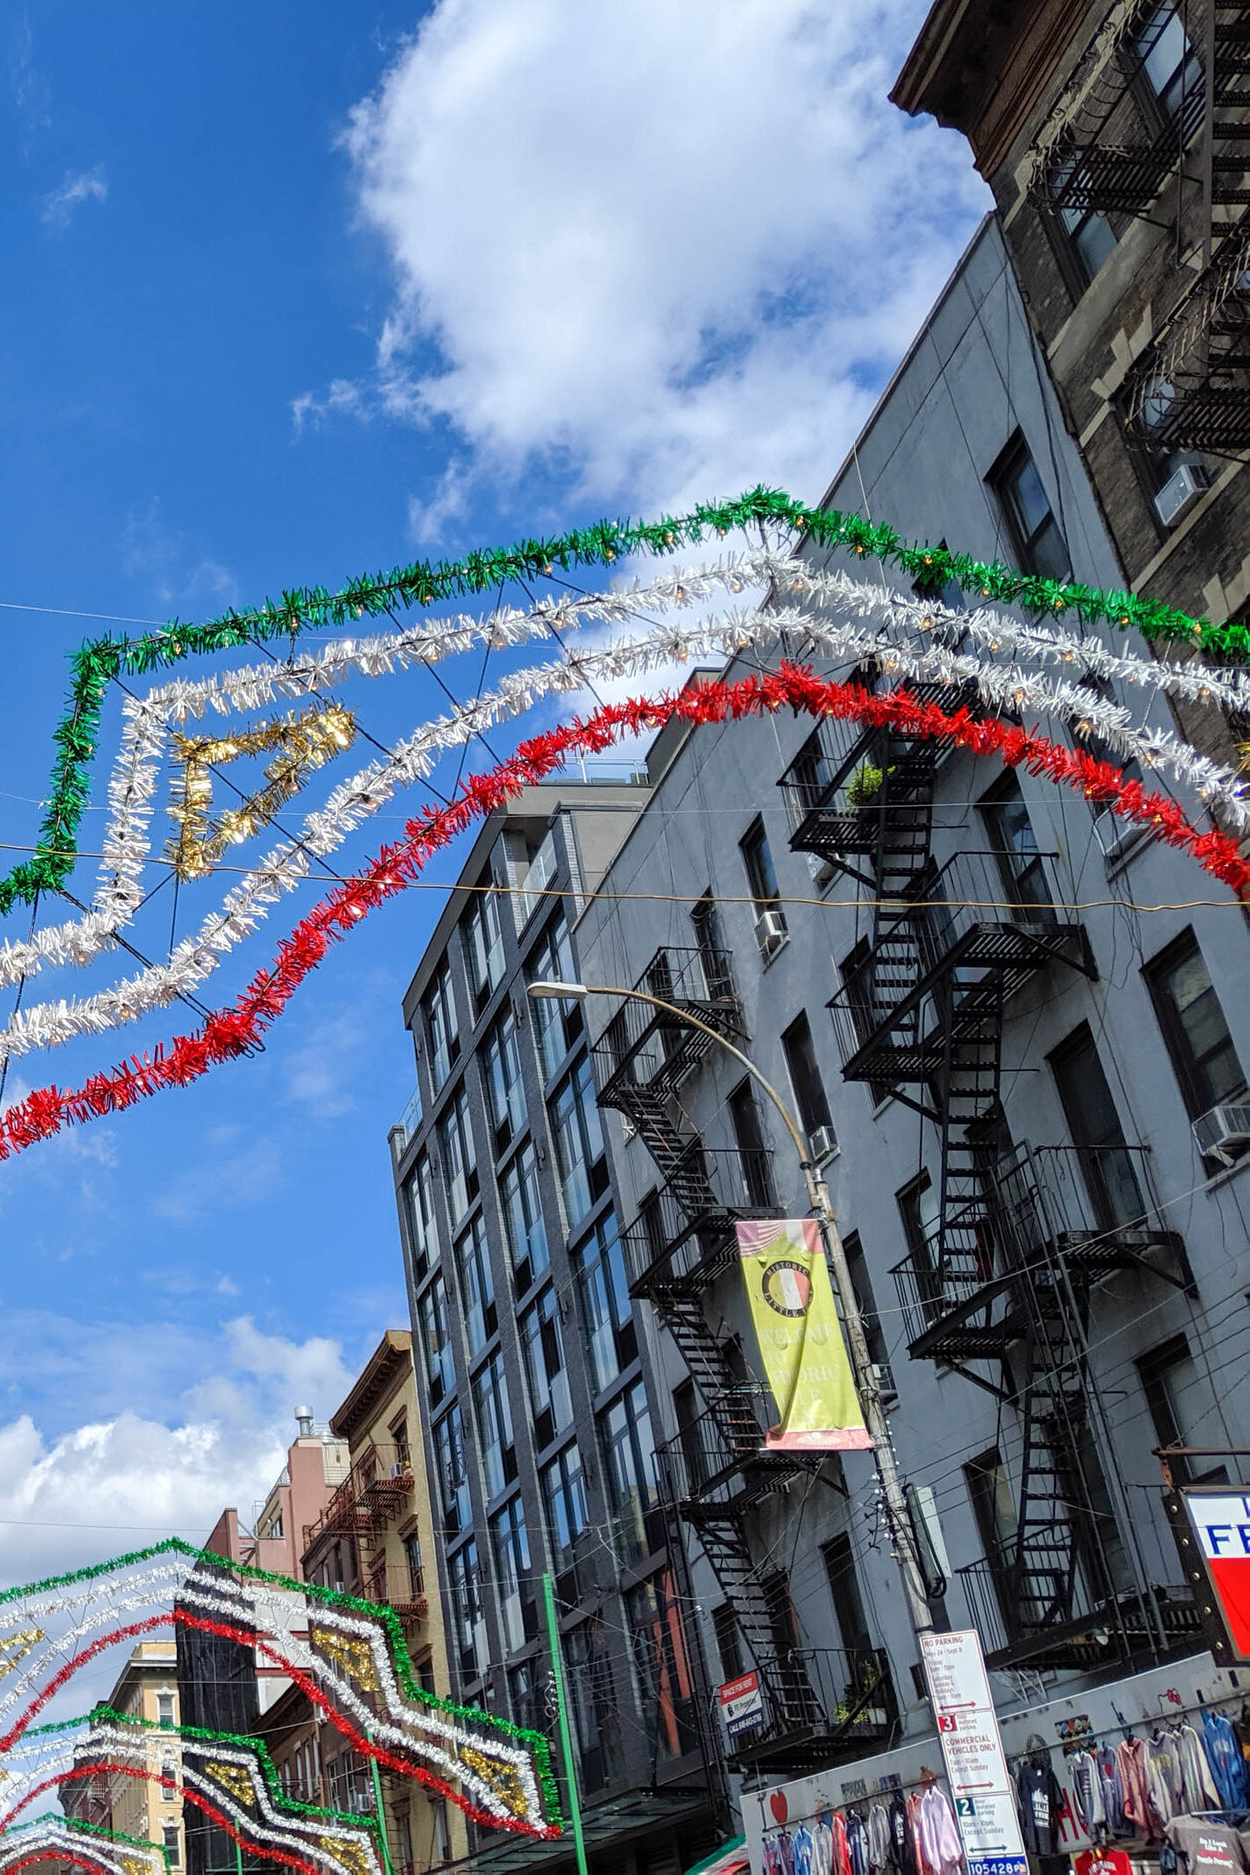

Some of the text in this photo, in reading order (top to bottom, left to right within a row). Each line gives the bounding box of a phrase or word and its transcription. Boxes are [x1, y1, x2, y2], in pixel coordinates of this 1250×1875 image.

[767, 1262, 809, 1276] HISTORIC
[935, 1636, 963, 1645] PARKING
[944, 1715, 953, 1730] 3
[946, 1734, 990, 1746] COMMERCIAL
[948, 1743, 996, 1755] VEHICLES ONLY
[960, 1799, 971, 1815] 2
[971, 1863, 1013, 1874] 105428
